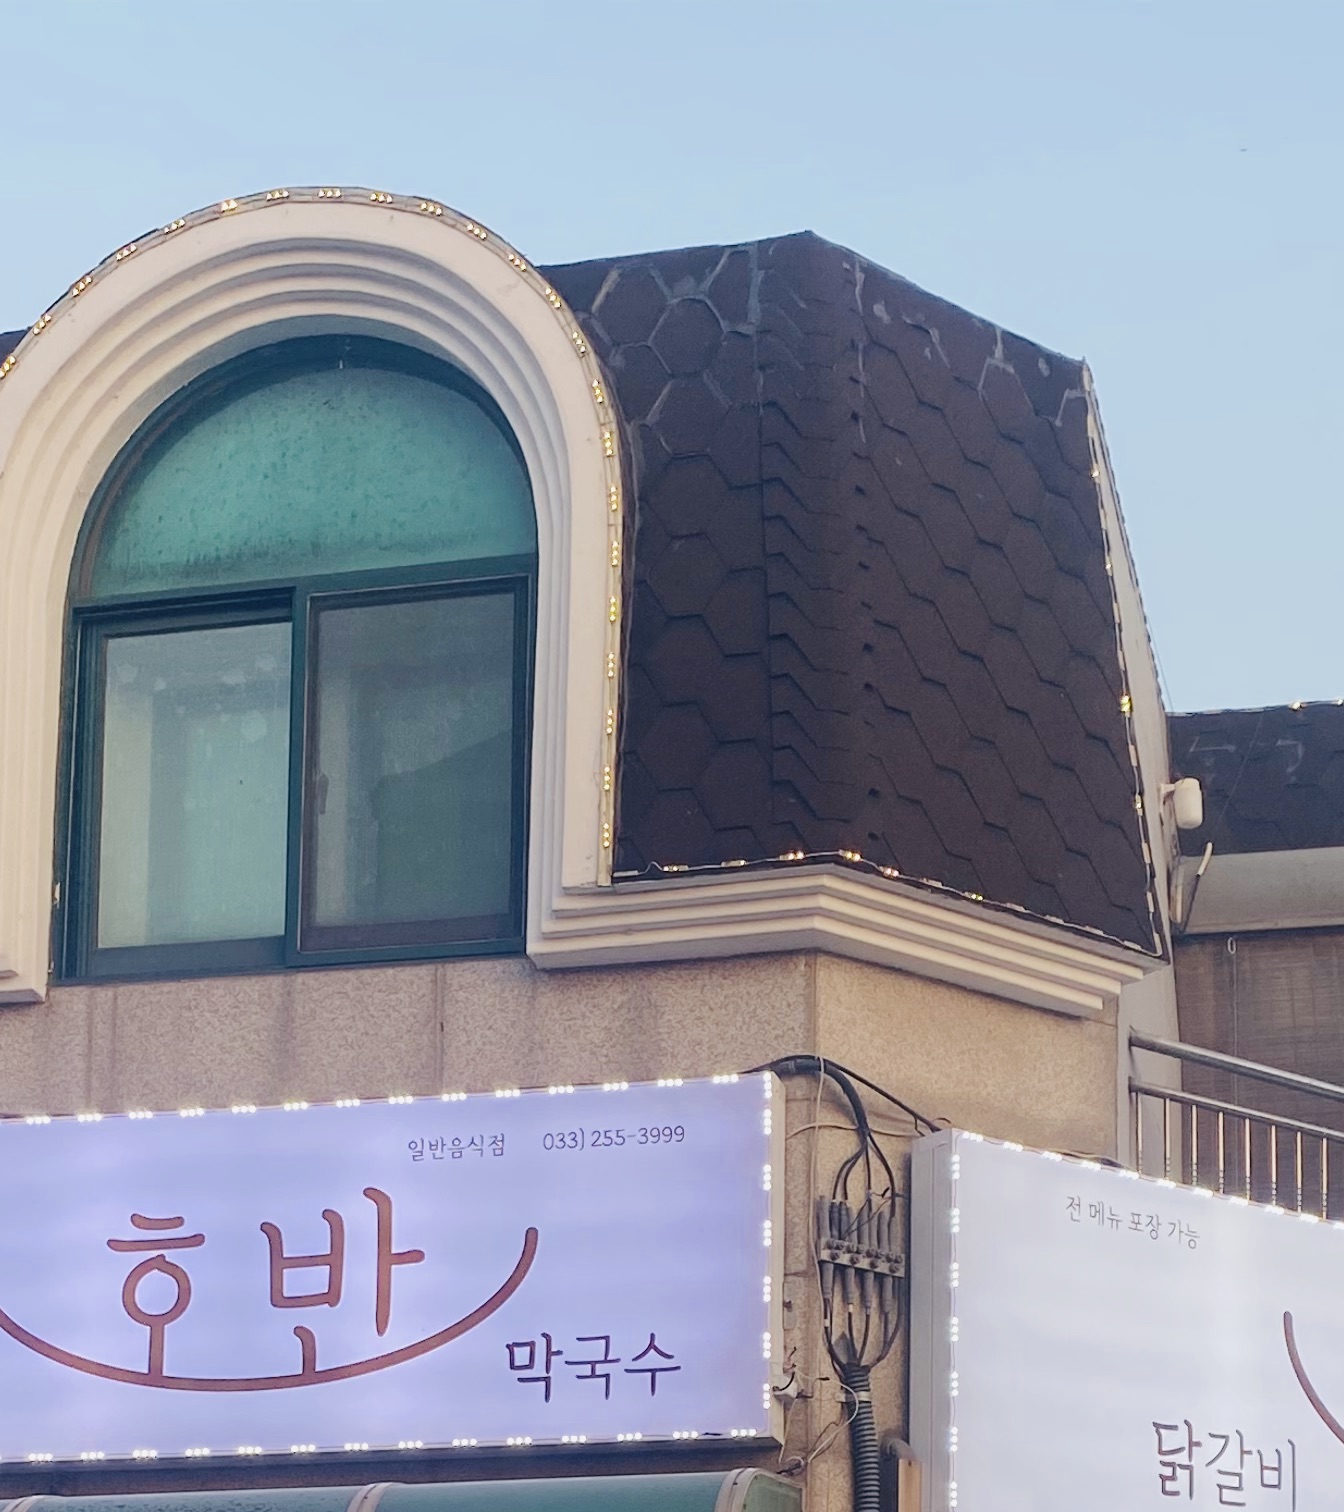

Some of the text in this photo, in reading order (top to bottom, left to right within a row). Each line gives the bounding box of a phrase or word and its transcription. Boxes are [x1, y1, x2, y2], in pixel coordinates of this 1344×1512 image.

[408, 1133, 505, 1161] 일반음식점
[1066, 1195, 1200, 1249] 전 메뉴 포장 가능
[106, 1187, 426, 1392] 호반
[505, 1332, 682, 1403] 막국수
[1152, 1419, 1296, 1512] 닭갈비
